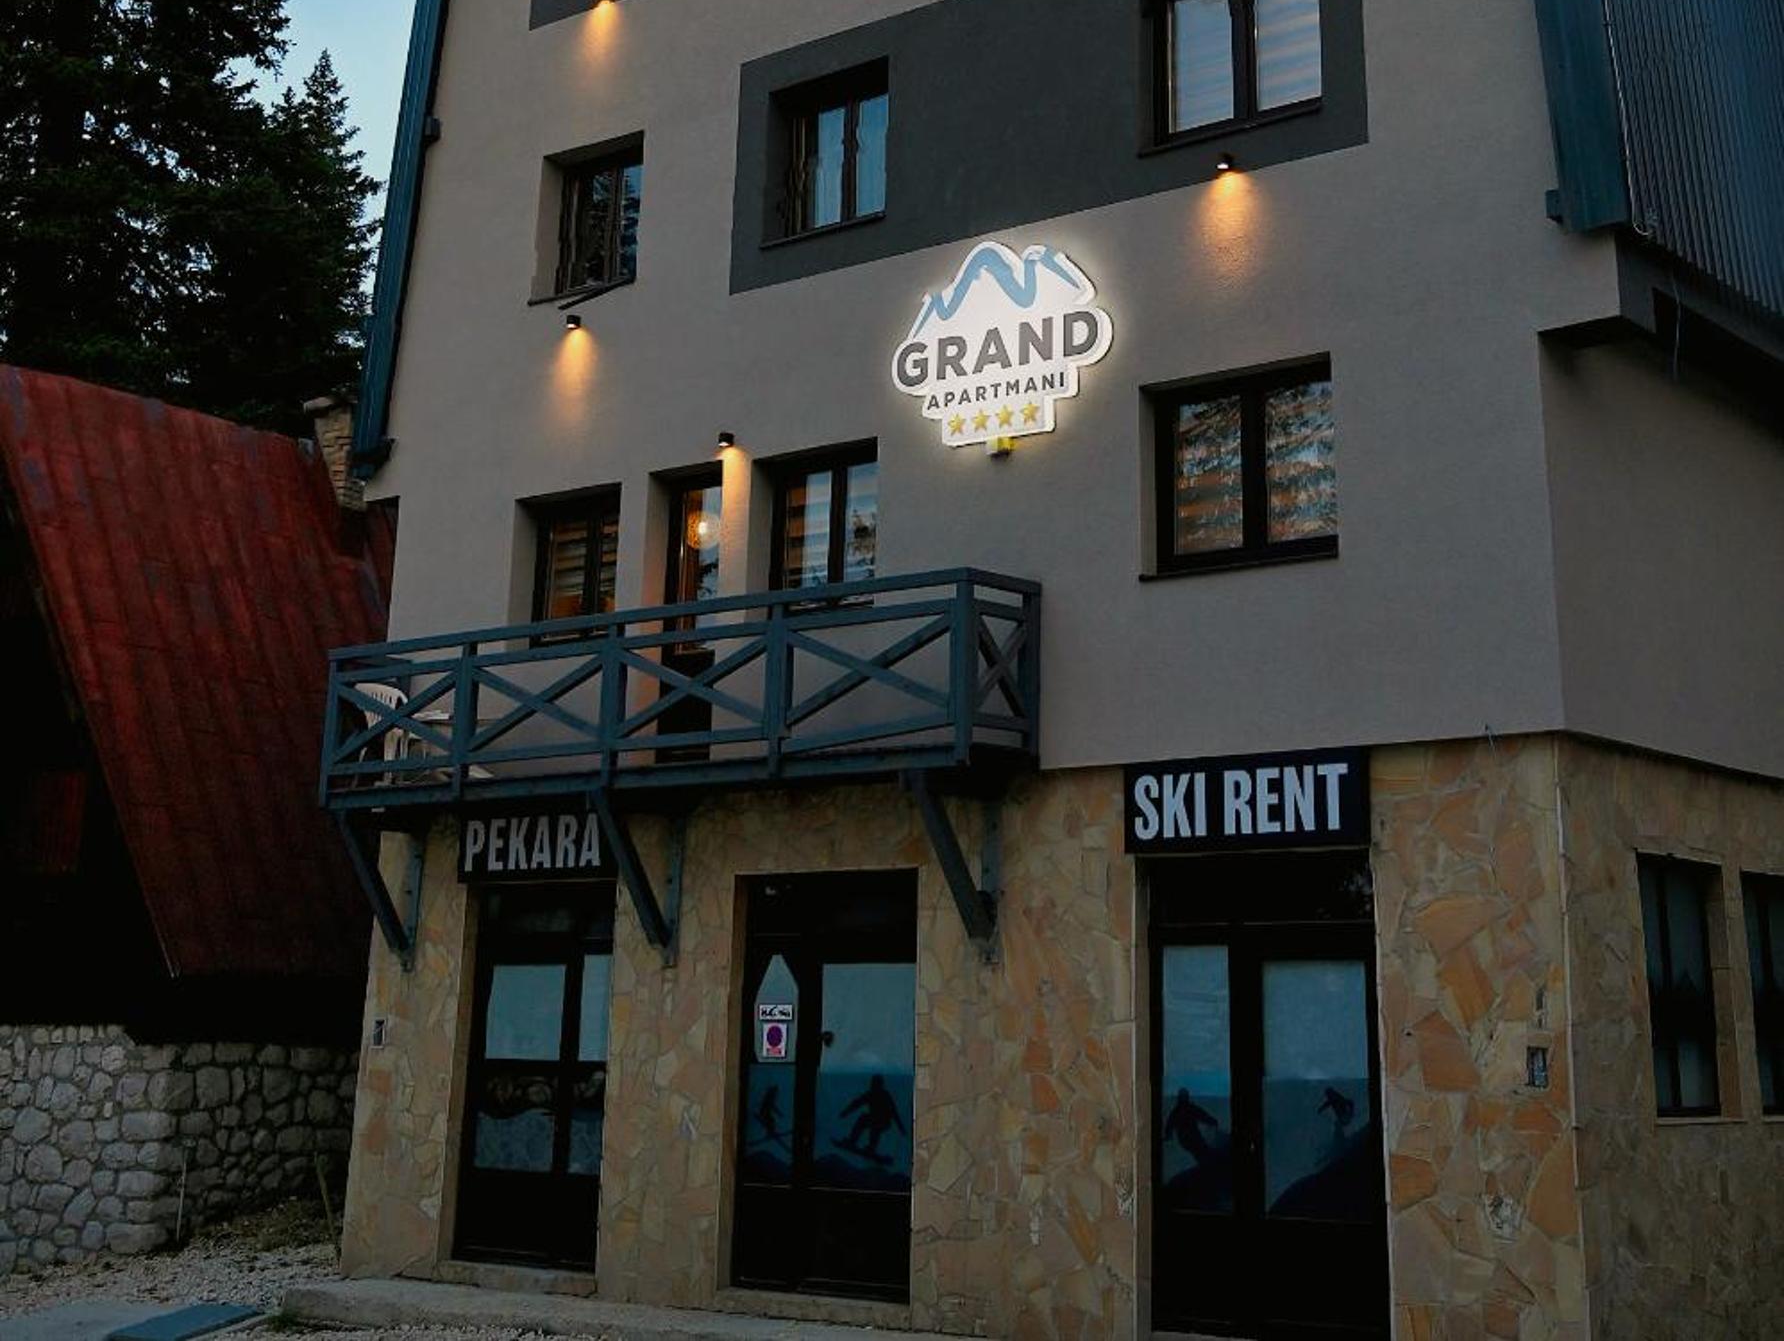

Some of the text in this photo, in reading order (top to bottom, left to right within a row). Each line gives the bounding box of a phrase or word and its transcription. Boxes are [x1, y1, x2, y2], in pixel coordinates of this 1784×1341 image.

[896, 310, 1099, 388] GRAND
[926, 371, 1066, 411] APARTMANI
[1134, 762, 1349, 841] SKI RENT
[463, 812, 601, 873] PEKARA
